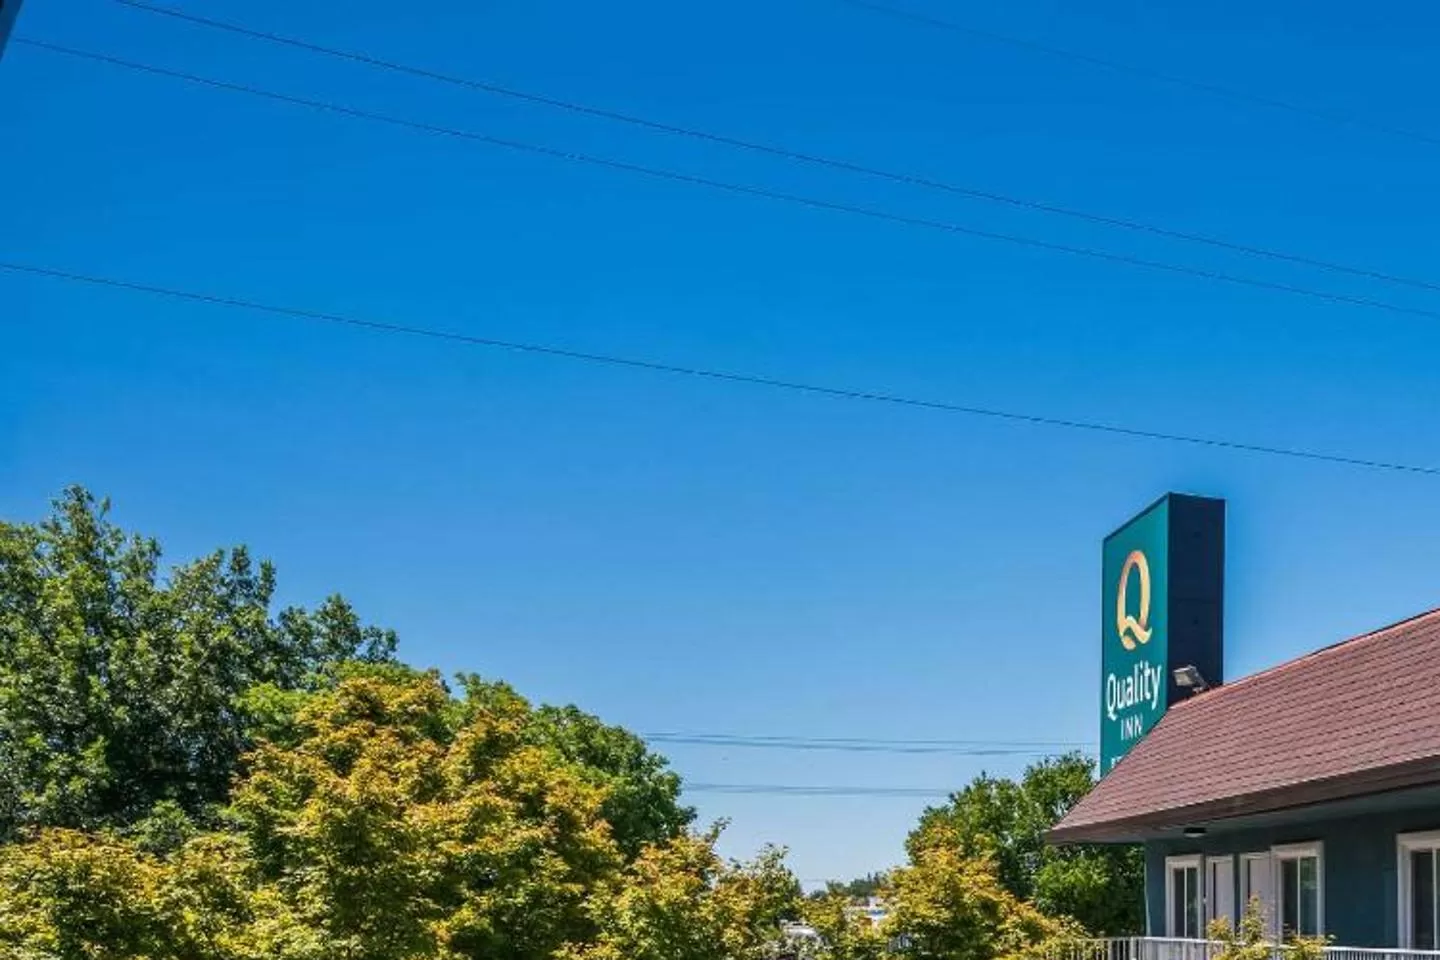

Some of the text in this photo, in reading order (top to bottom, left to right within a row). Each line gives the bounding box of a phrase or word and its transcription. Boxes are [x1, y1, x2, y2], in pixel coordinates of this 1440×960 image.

[1117, 550, 1152, 650] Q
[1107, 660, 1162, 721] Quality
[1121, 713, 1144, 740] INN
